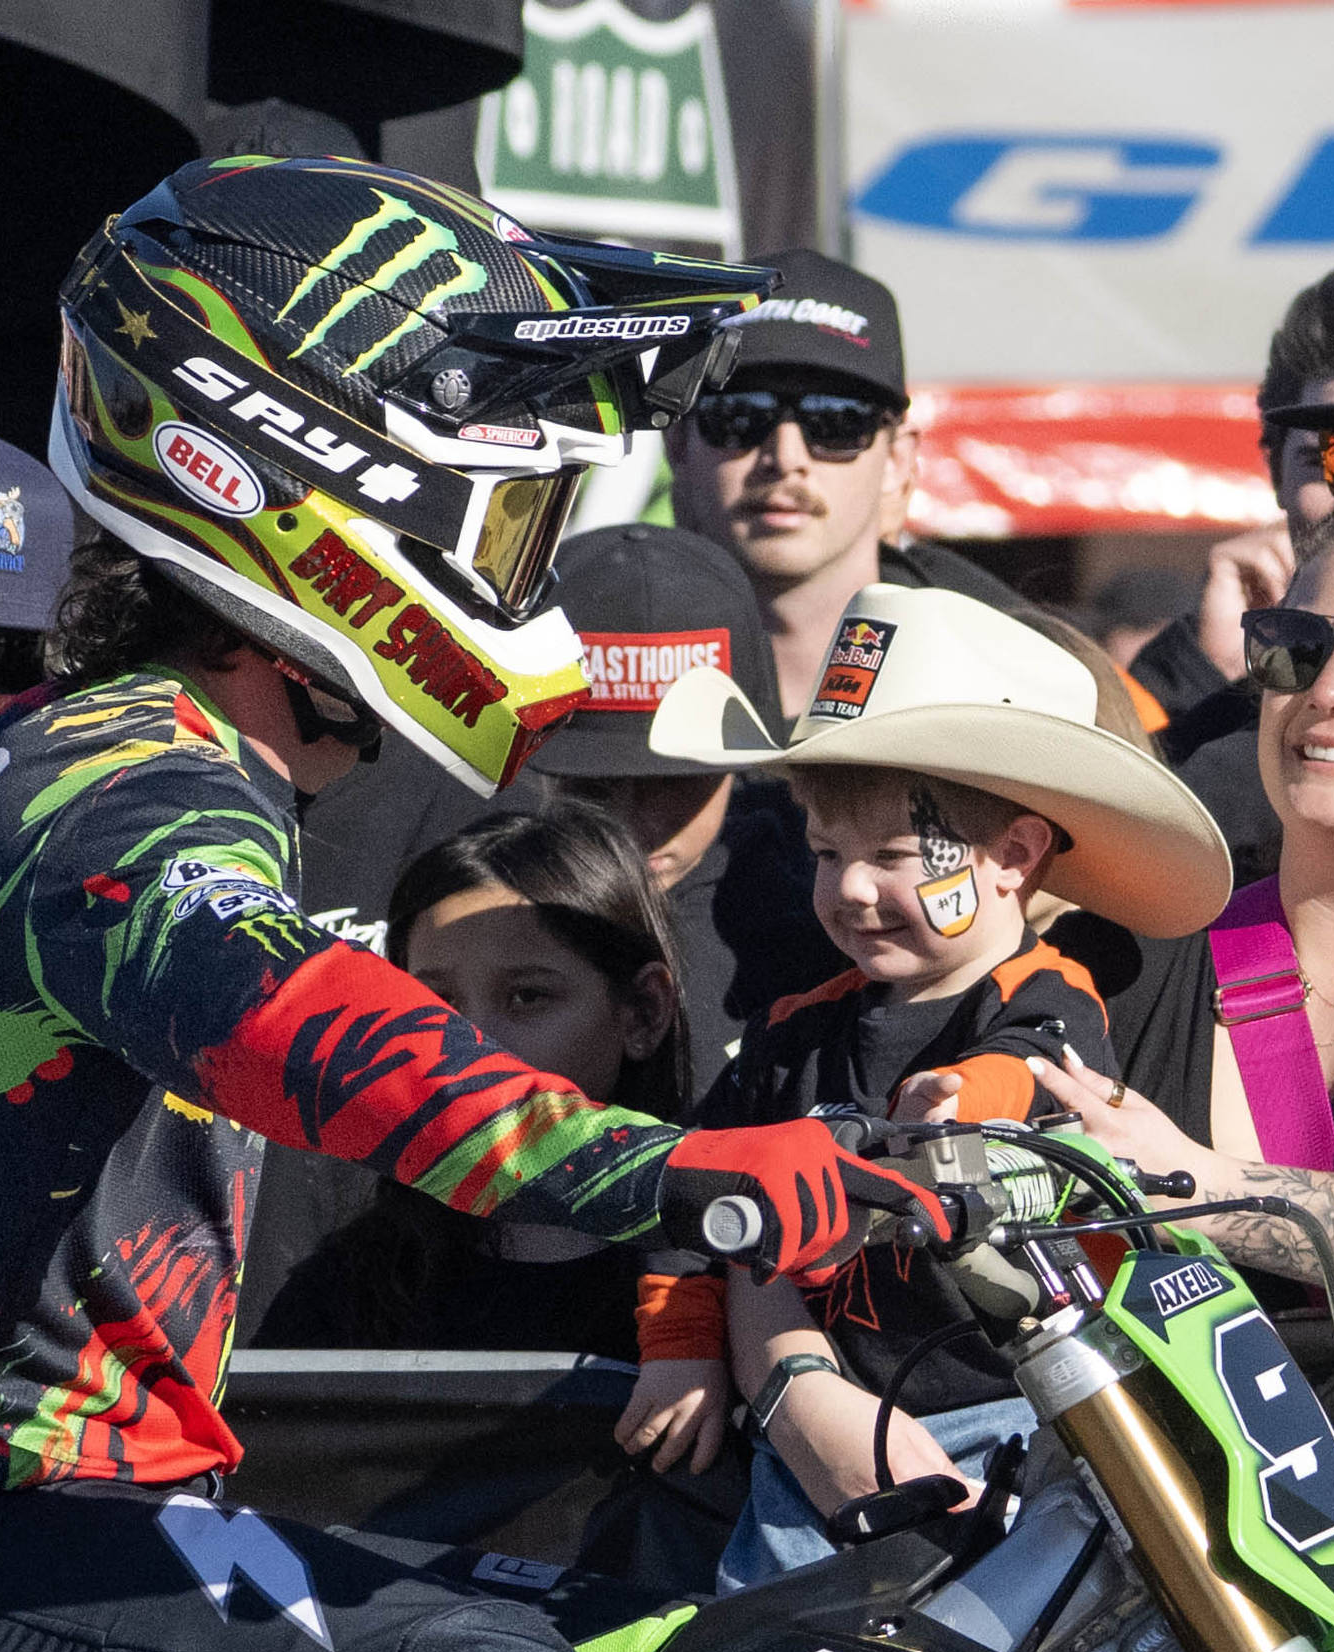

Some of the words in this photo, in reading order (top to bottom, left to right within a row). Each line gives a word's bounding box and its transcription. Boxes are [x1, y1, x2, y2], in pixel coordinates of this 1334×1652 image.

[515, 314, 691, 342] apdesigns
[172, 356, 370, 473] SPY
[166, 434, 242, 507] BELL
[287, 527, 405, 630] DIRT
[373, 606, 509, 730] SHARK
[585, 641, 720, 683] ASTHOUSE
